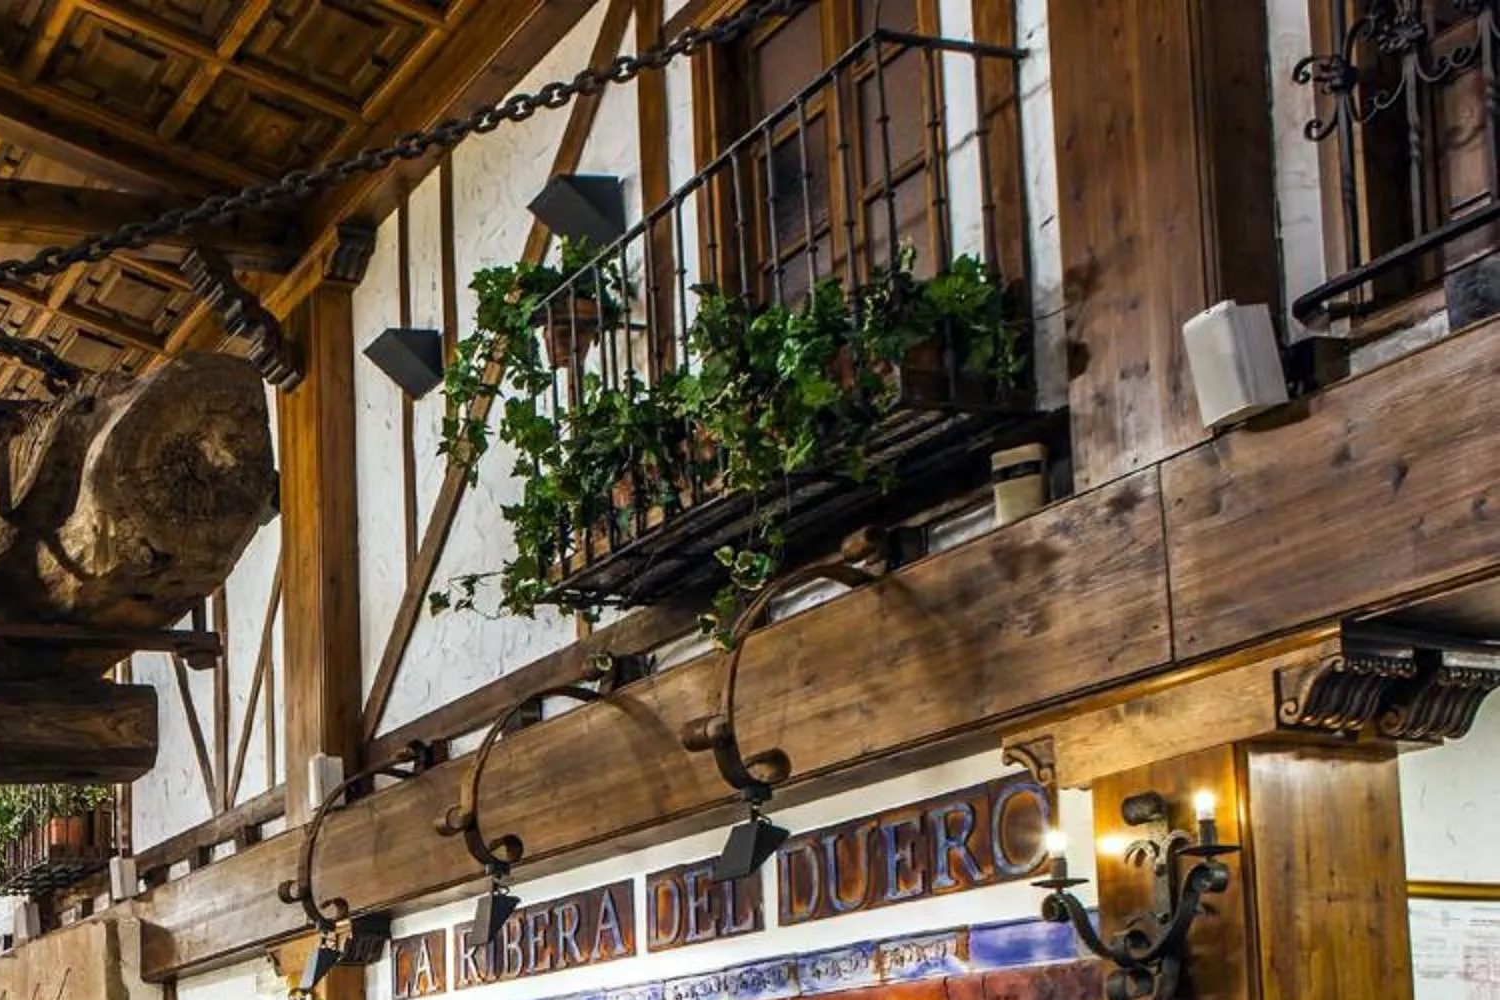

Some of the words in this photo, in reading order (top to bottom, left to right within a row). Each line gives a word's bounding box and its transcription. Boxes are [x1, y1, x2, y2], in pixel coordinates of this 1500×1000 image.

[391, 936, 439, 1000] LA
[646, 862, 755, 946] DEL
[779, 783, 1055, 919] DUERO
